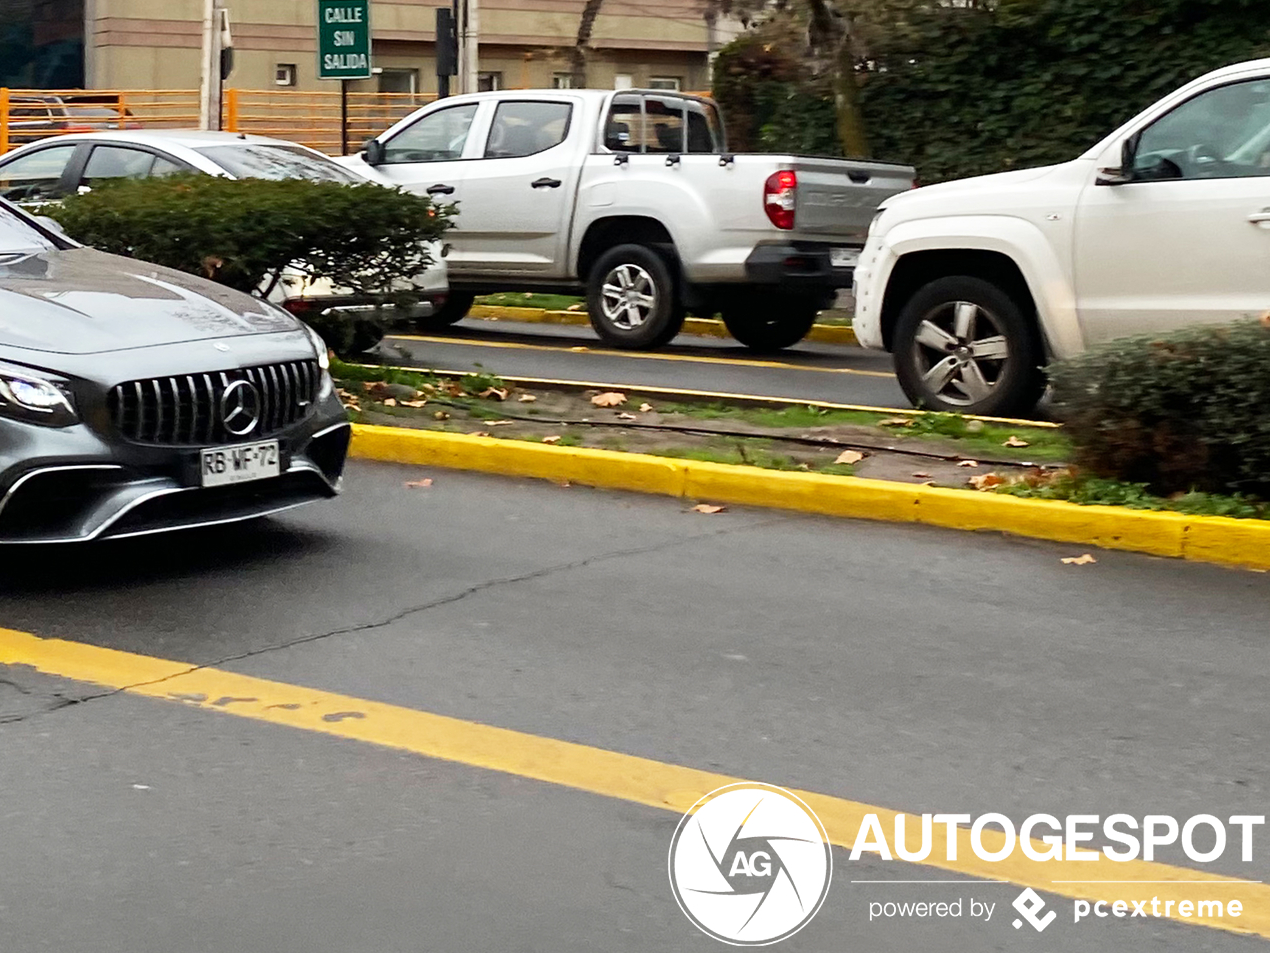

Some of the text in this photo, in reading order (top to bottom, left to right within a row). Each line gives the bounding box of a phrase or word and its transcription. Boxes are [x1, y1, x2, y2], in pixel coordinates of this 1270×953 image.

[325, 7, 362, 23] CALLE
[333, 30, 355, 46] SIN
[324, 53, 368, 70] SALIDA
